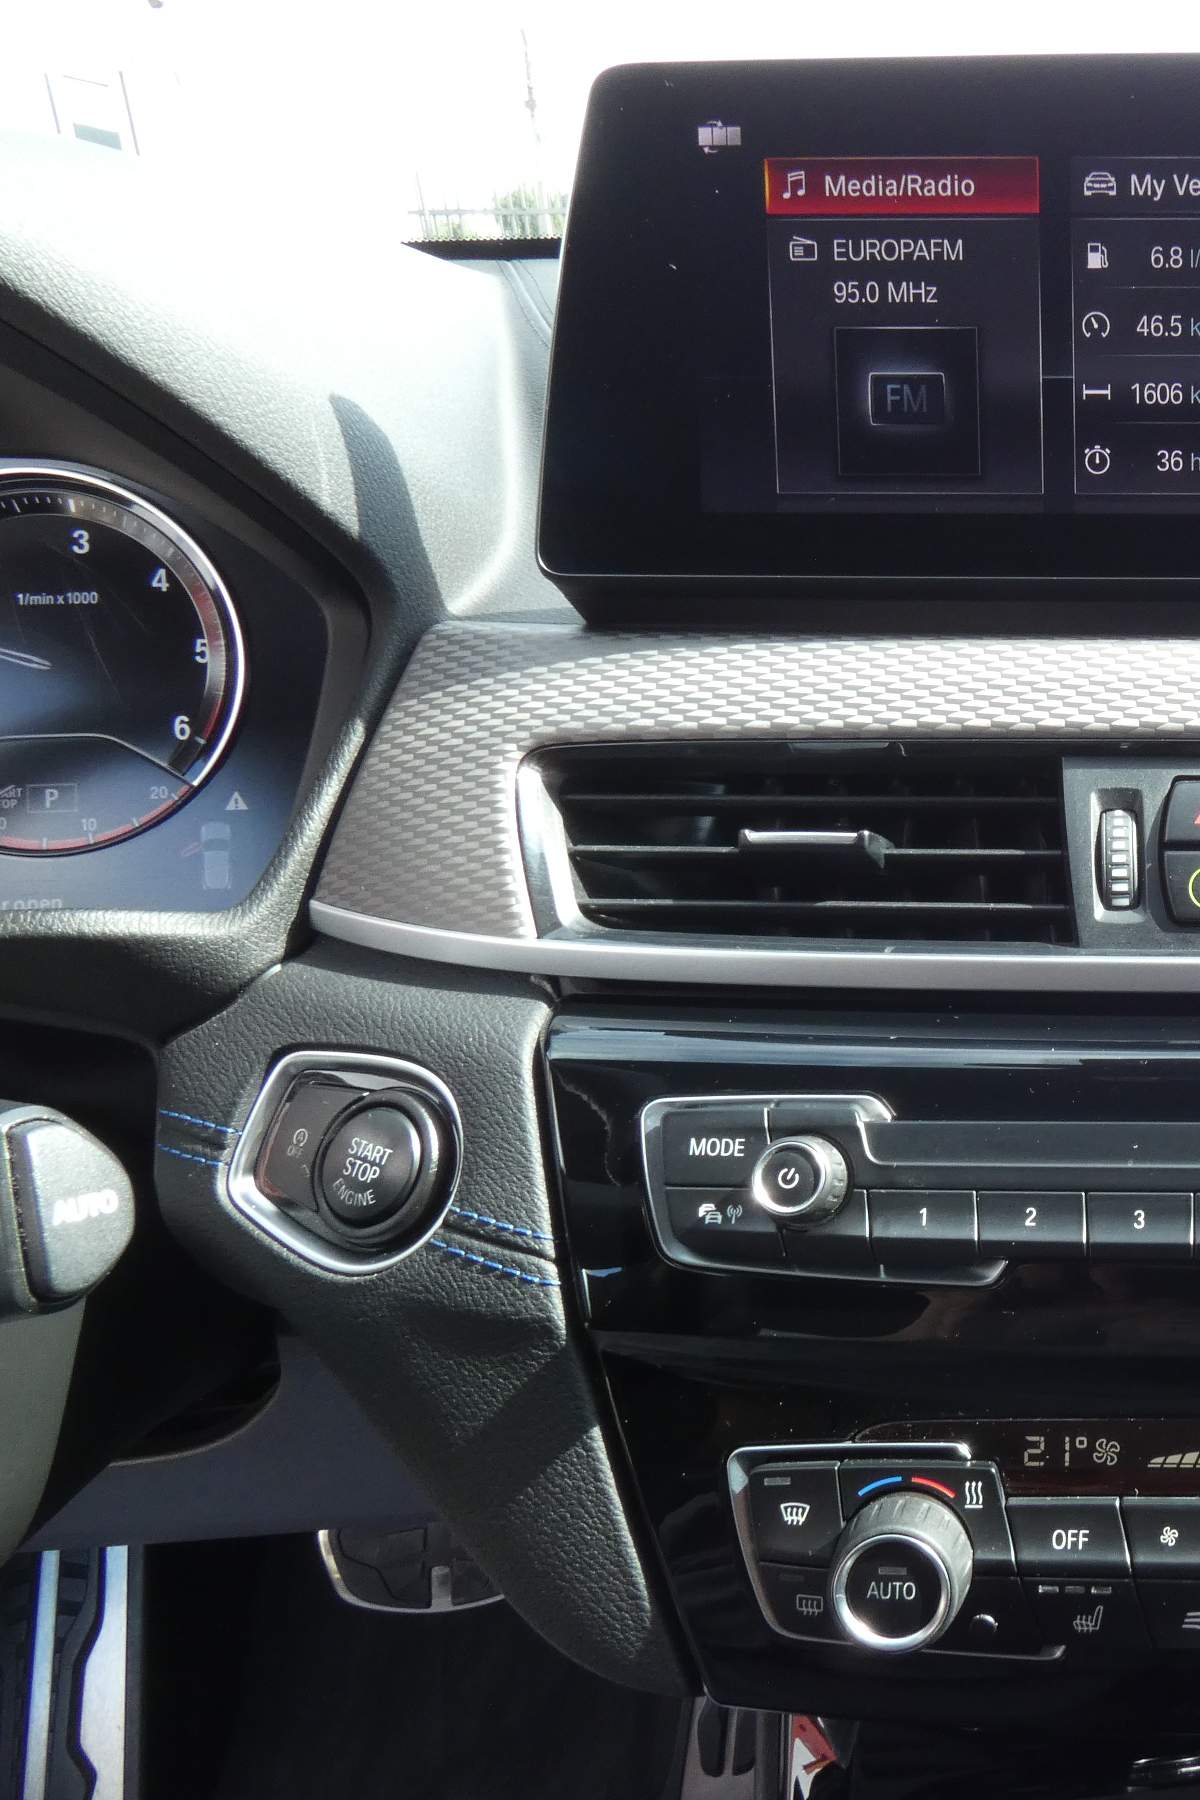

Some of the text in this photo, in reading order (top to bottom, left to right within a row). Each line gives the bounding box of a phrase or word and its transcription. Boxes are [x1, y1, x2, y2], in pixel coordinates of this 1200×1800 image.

[824, 173, 976, 199] Media/Radio
[1130, 173, 1166, 201] My
[833, 239, 964, 262] EUROPAFM
[1150, 246, 1183, 269] 6.8
[833, 281, 938, 304] 95.0 MHz
[1136, 315, 1183, 337] 46.5
[886, 384, 928, 413] FM
[1131, 383, 1183, 405] 1606
[1156, 450, 1183, 471] 36
[71, 529, 90, 555] 3
[152, 568, 170, 592] 4
[17, 593, 54, 606] 1/min
[66, 592, 98, 605] 1000
[194, 639, 208, 664] 5
[174, 716, 190, 741] 6
[45, 789, 58, 809] P
[151, 786, 168, 800] 20
[81, 818, 97, 831] 10
[348, 1137, 393, 1165] START
[689, 1137, 745, 1157] MODE
[343, 1157, 380, 1183] STOP
[332, 1178, 377, 1206] ENGINE
[52, 1189, 119, 1226] AUTO
[919, 1208, 928, 1227] 1
[1025, 1208, 1036, 1227] 2
[1133, 1210, 1145, 1230] 3
[1052, 1530, 1089, 1550] OFF
[866, 1582, 916, 1601] AUTO
